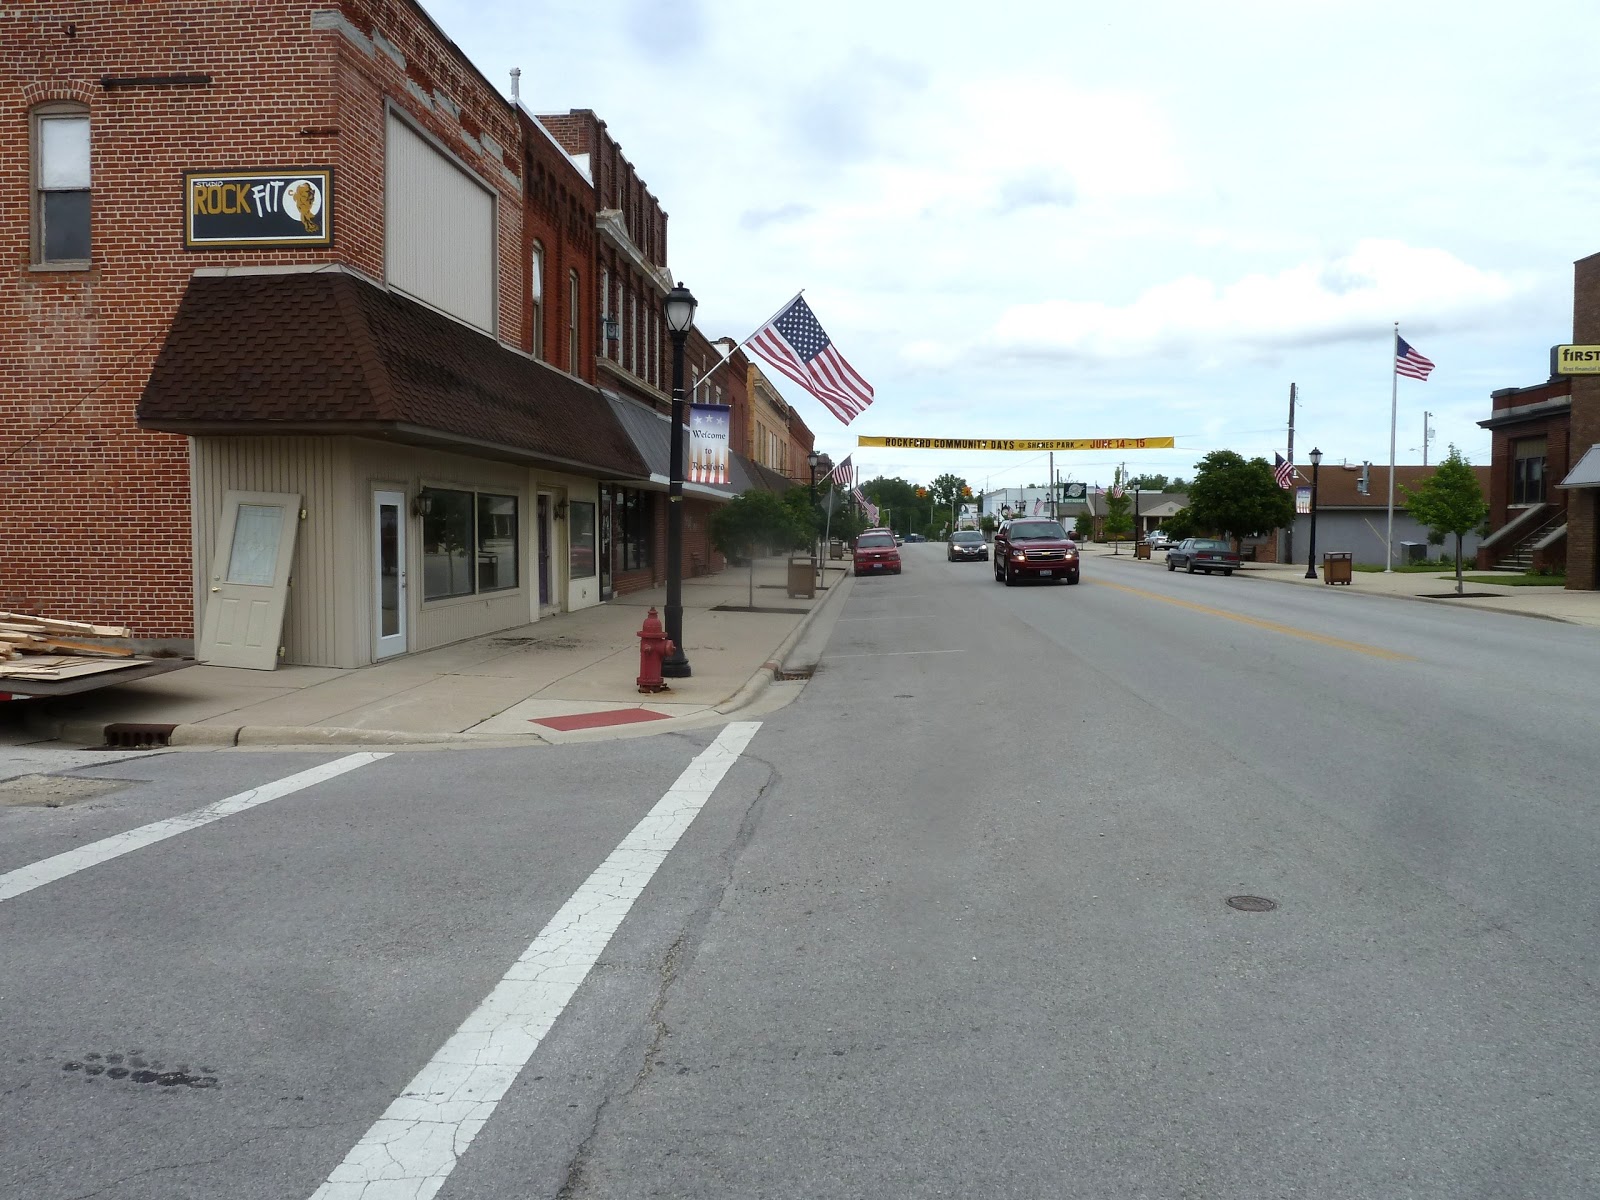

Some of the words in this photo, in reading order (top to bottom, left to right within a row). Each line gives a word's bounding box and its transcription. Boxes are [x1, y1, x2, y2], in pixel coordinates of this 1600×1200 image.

[193, 183, 252, 215] ROCK
[251, 180, 285, 218] FIT
[692, 429, 726, 440] Welcome
[885, 437, 931, 448] ROCKFORD
[934, 439, 987, 449] COMMUNITY
[991, 440, 1015, 450] DAYS
[1089, 439, 1112, 449] JUNE
[1115, 439, 1125, 449] 14
[1135, 438, 1146, 448] 15
[704, 447, 713, 455] to
[691, 461, 725, 471] Rockford
